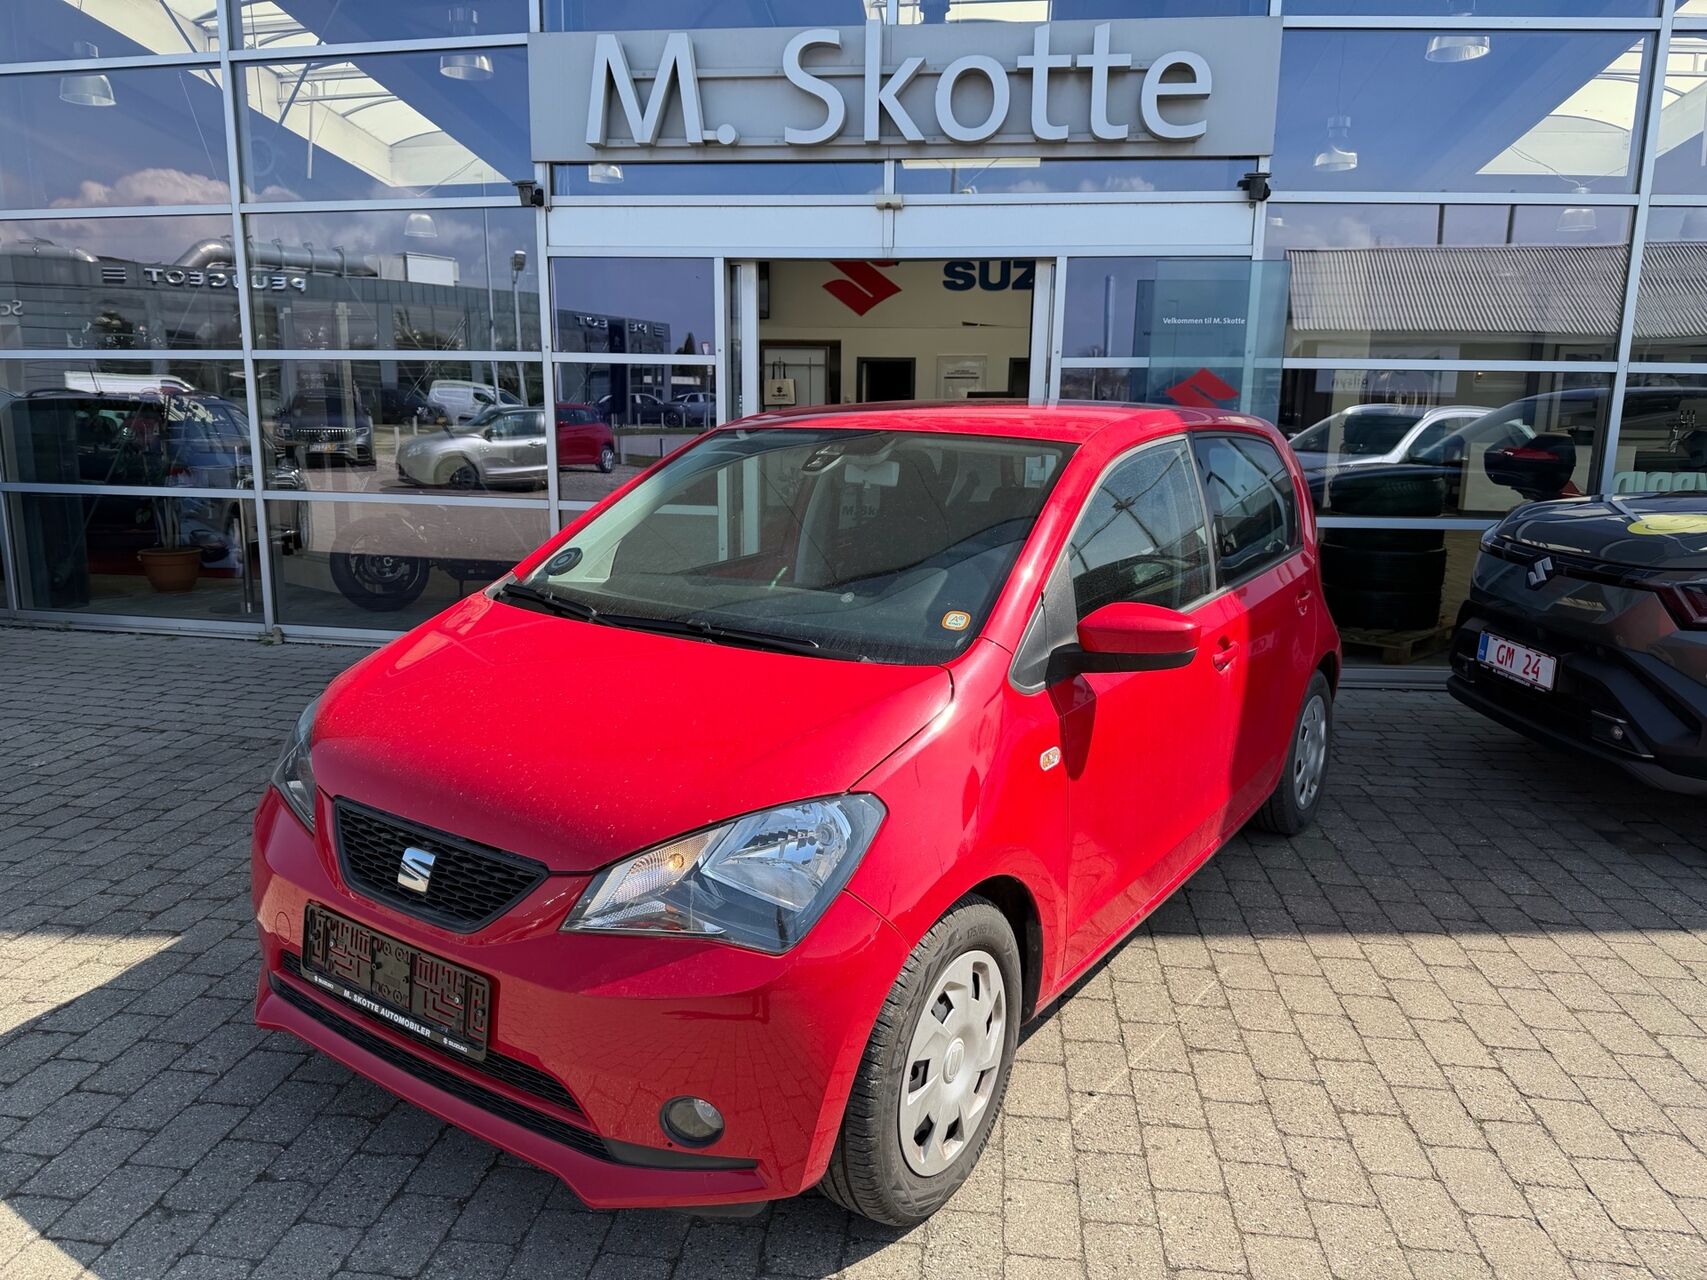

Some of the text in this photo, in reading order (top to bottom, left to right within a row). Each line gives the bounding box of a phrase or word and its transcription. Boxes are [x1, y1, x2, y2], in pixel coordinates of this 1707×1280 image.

[585, 19, 1213, 147] M. Skotte
[1162, 317, 1246, 325] Velkommen til M. Skotte
[1496, 644, 1516, 669] GM
[1522, 654, 1541, 680] 24
[343, 989, 432, 1038] M. SKOTTE AUTOMOBILER
